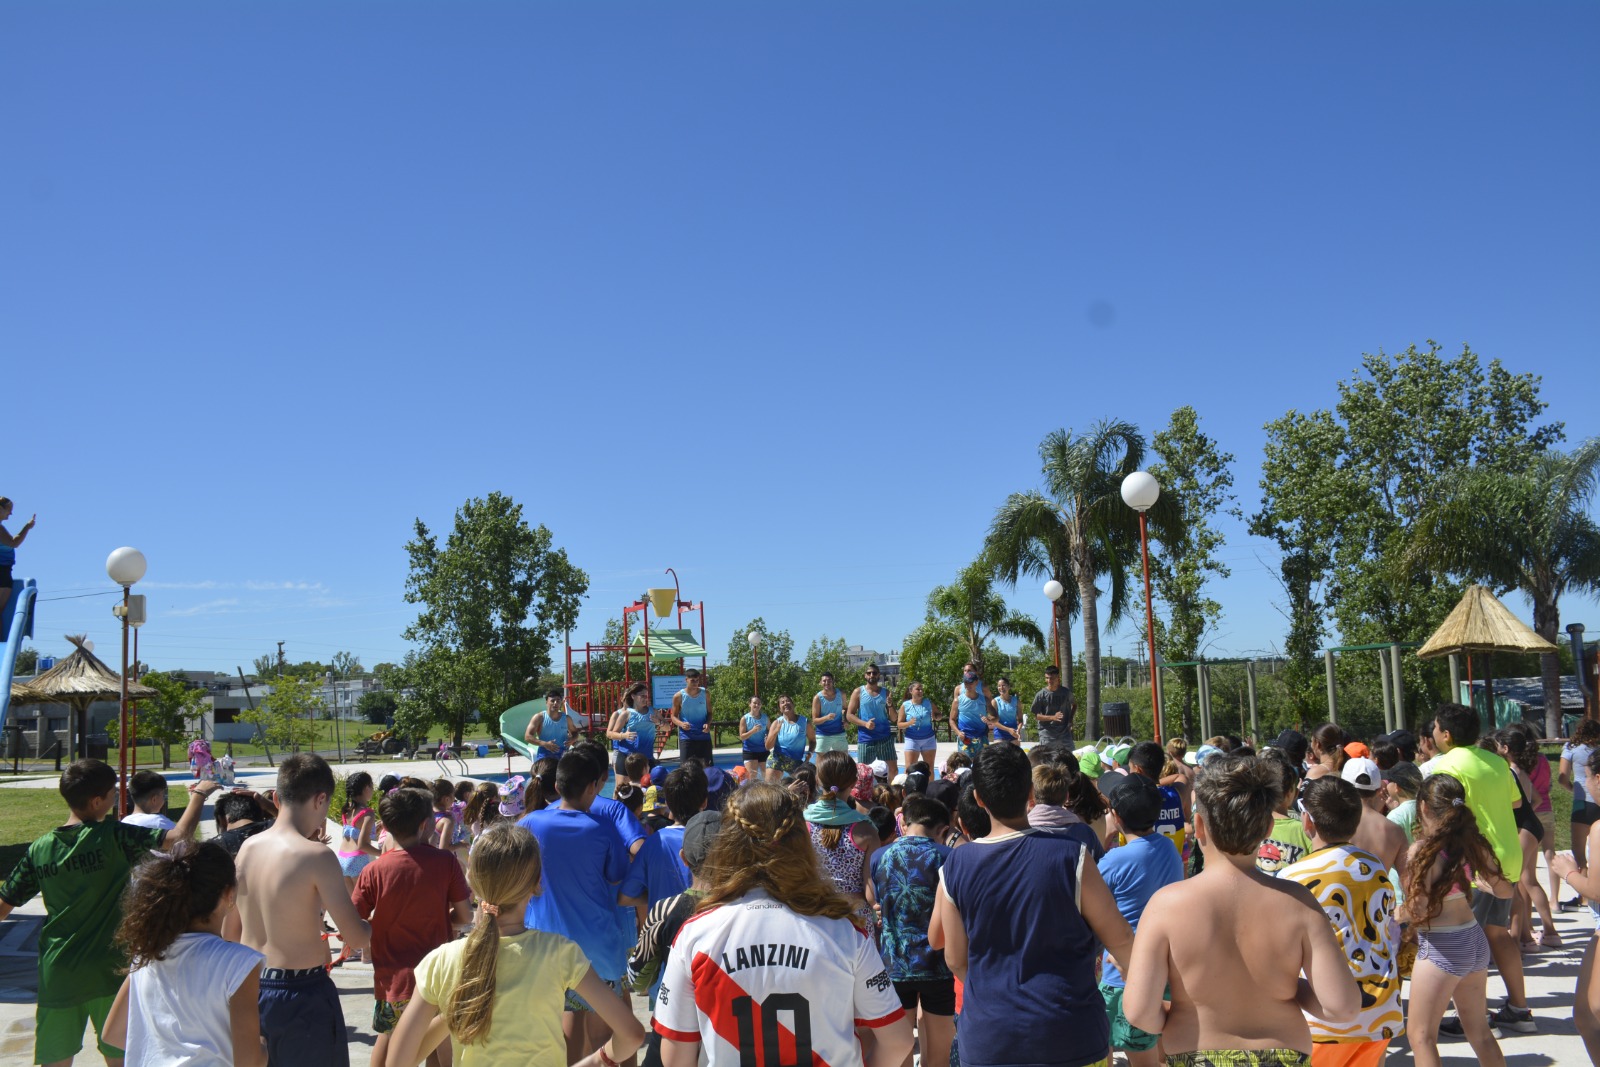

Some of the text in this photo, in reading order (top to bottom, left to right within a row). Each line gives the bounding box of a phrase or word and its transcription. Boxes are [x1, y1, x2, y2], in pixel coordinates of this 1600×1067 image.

[36, 848, 105, 880] ORO VERDE
[721, 943, 810, 975] LANZINI
[732, 993, 814, 1067] 10
